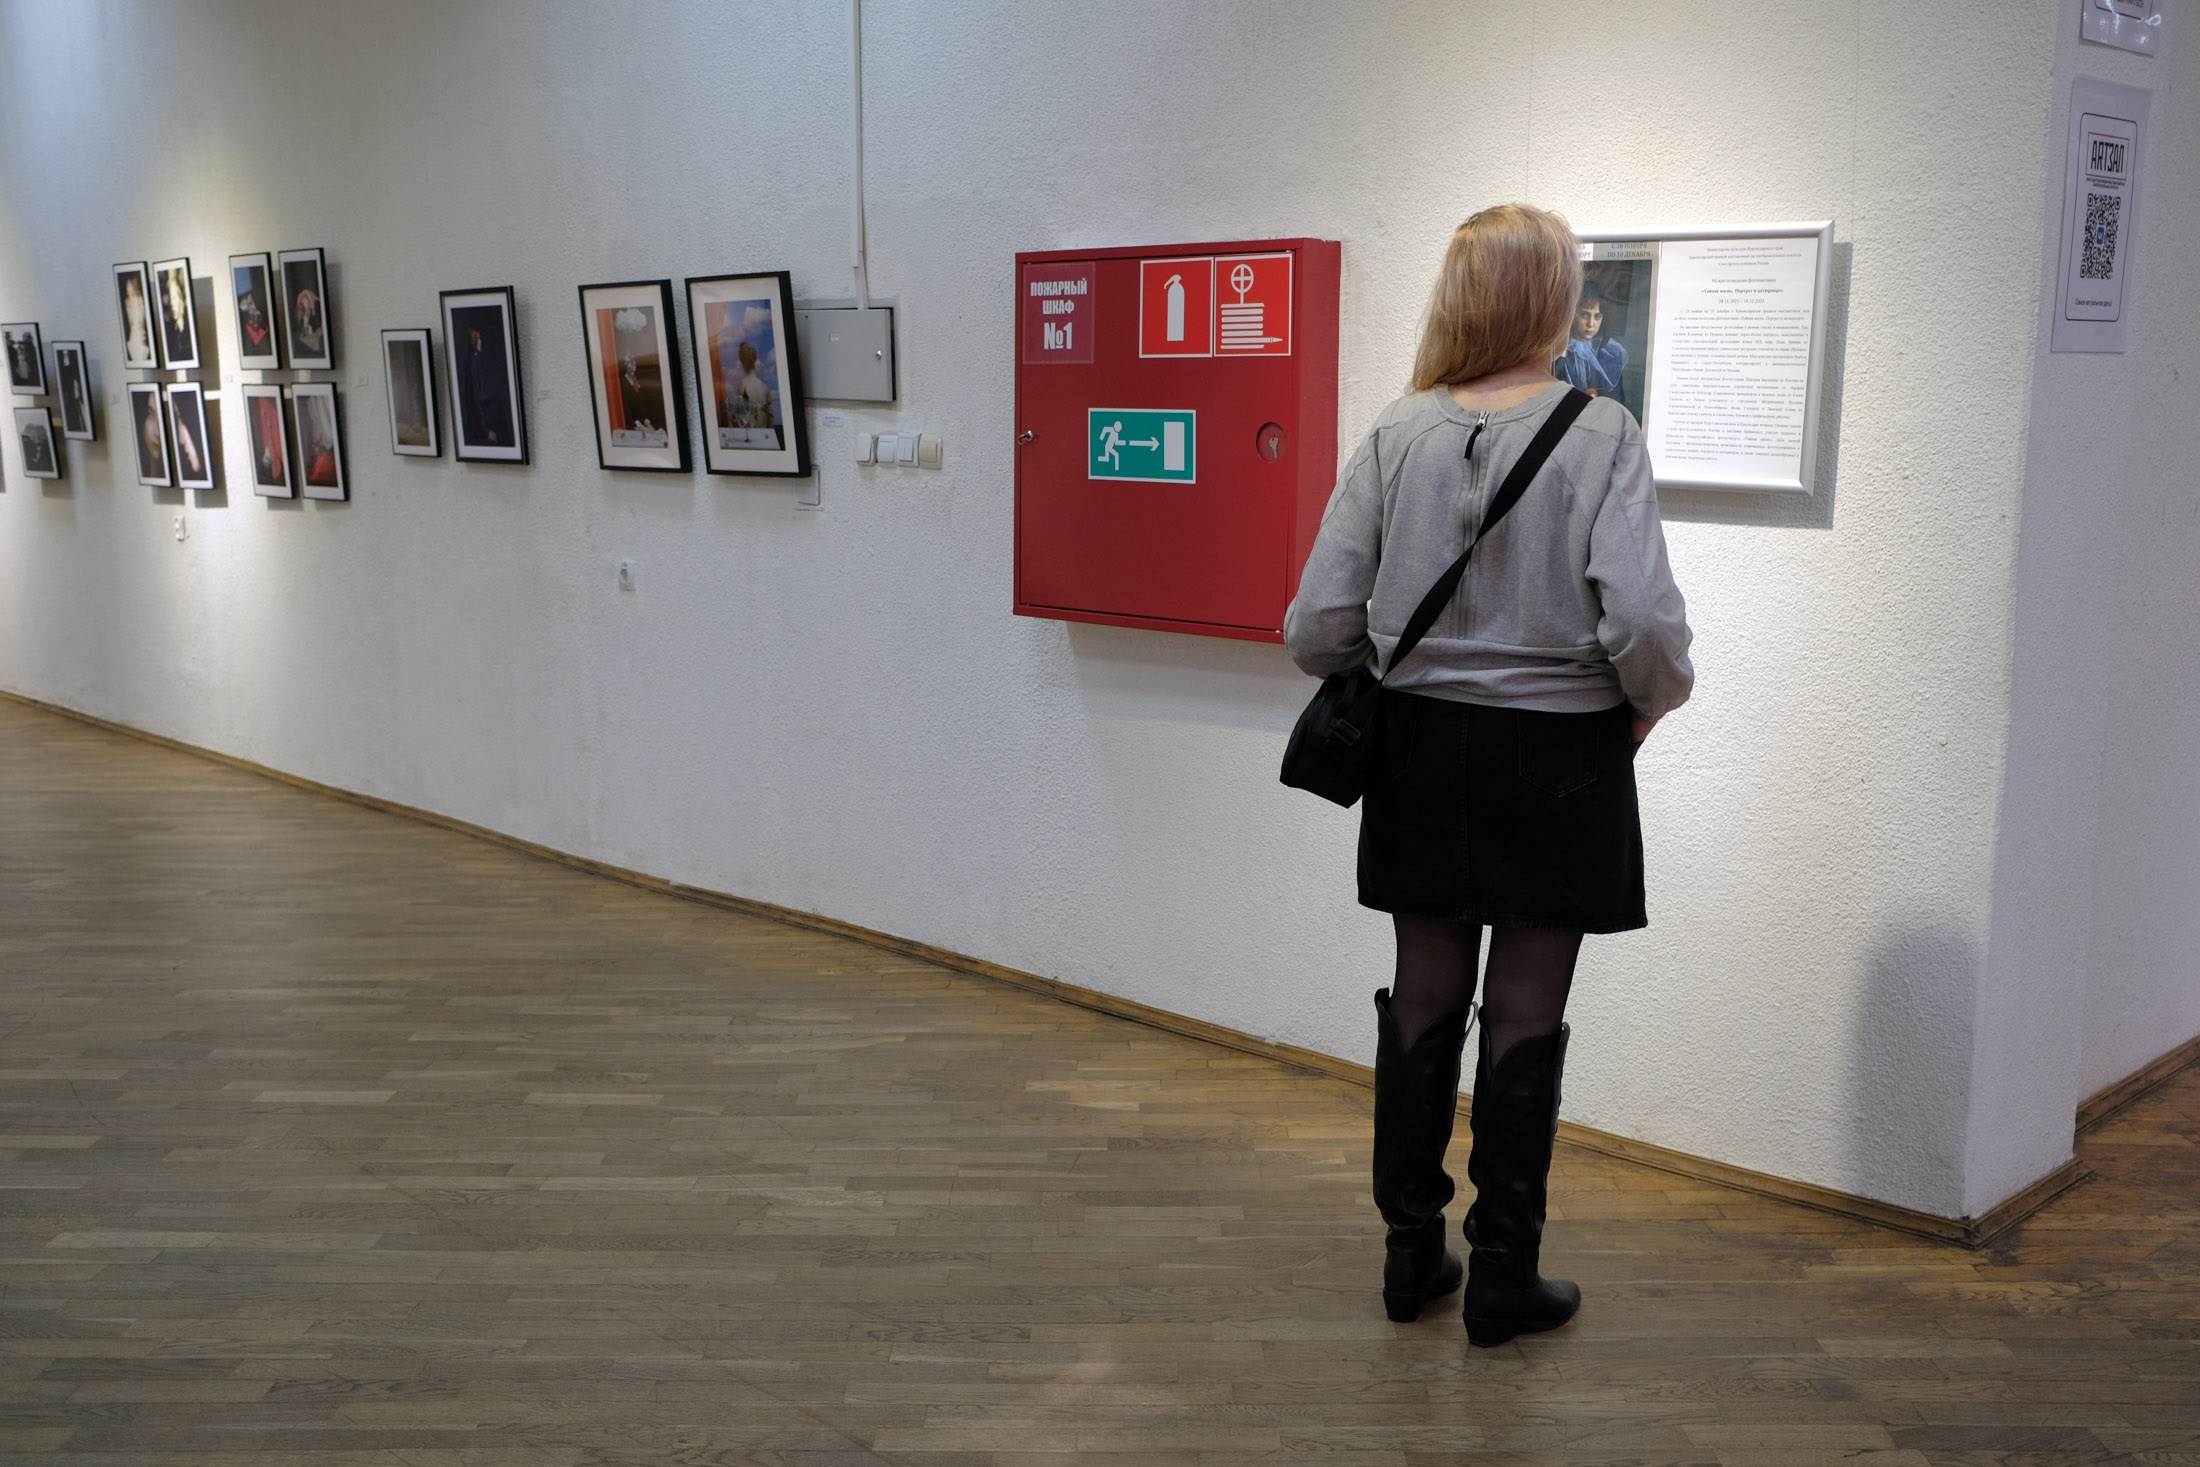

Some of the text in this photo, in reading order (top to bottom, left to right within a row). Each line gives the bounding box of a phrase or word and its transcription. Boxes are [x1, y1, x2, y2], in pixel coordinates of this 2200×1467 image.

[1624, 250, 1651, 258] ДЕКАБРЯ
[1030, 277, 1088, 297] ПОЖАРНЫЙ
[1042, 299, 1075, 315] ШКАФ
[1043, 321, 1073, 350] №1
